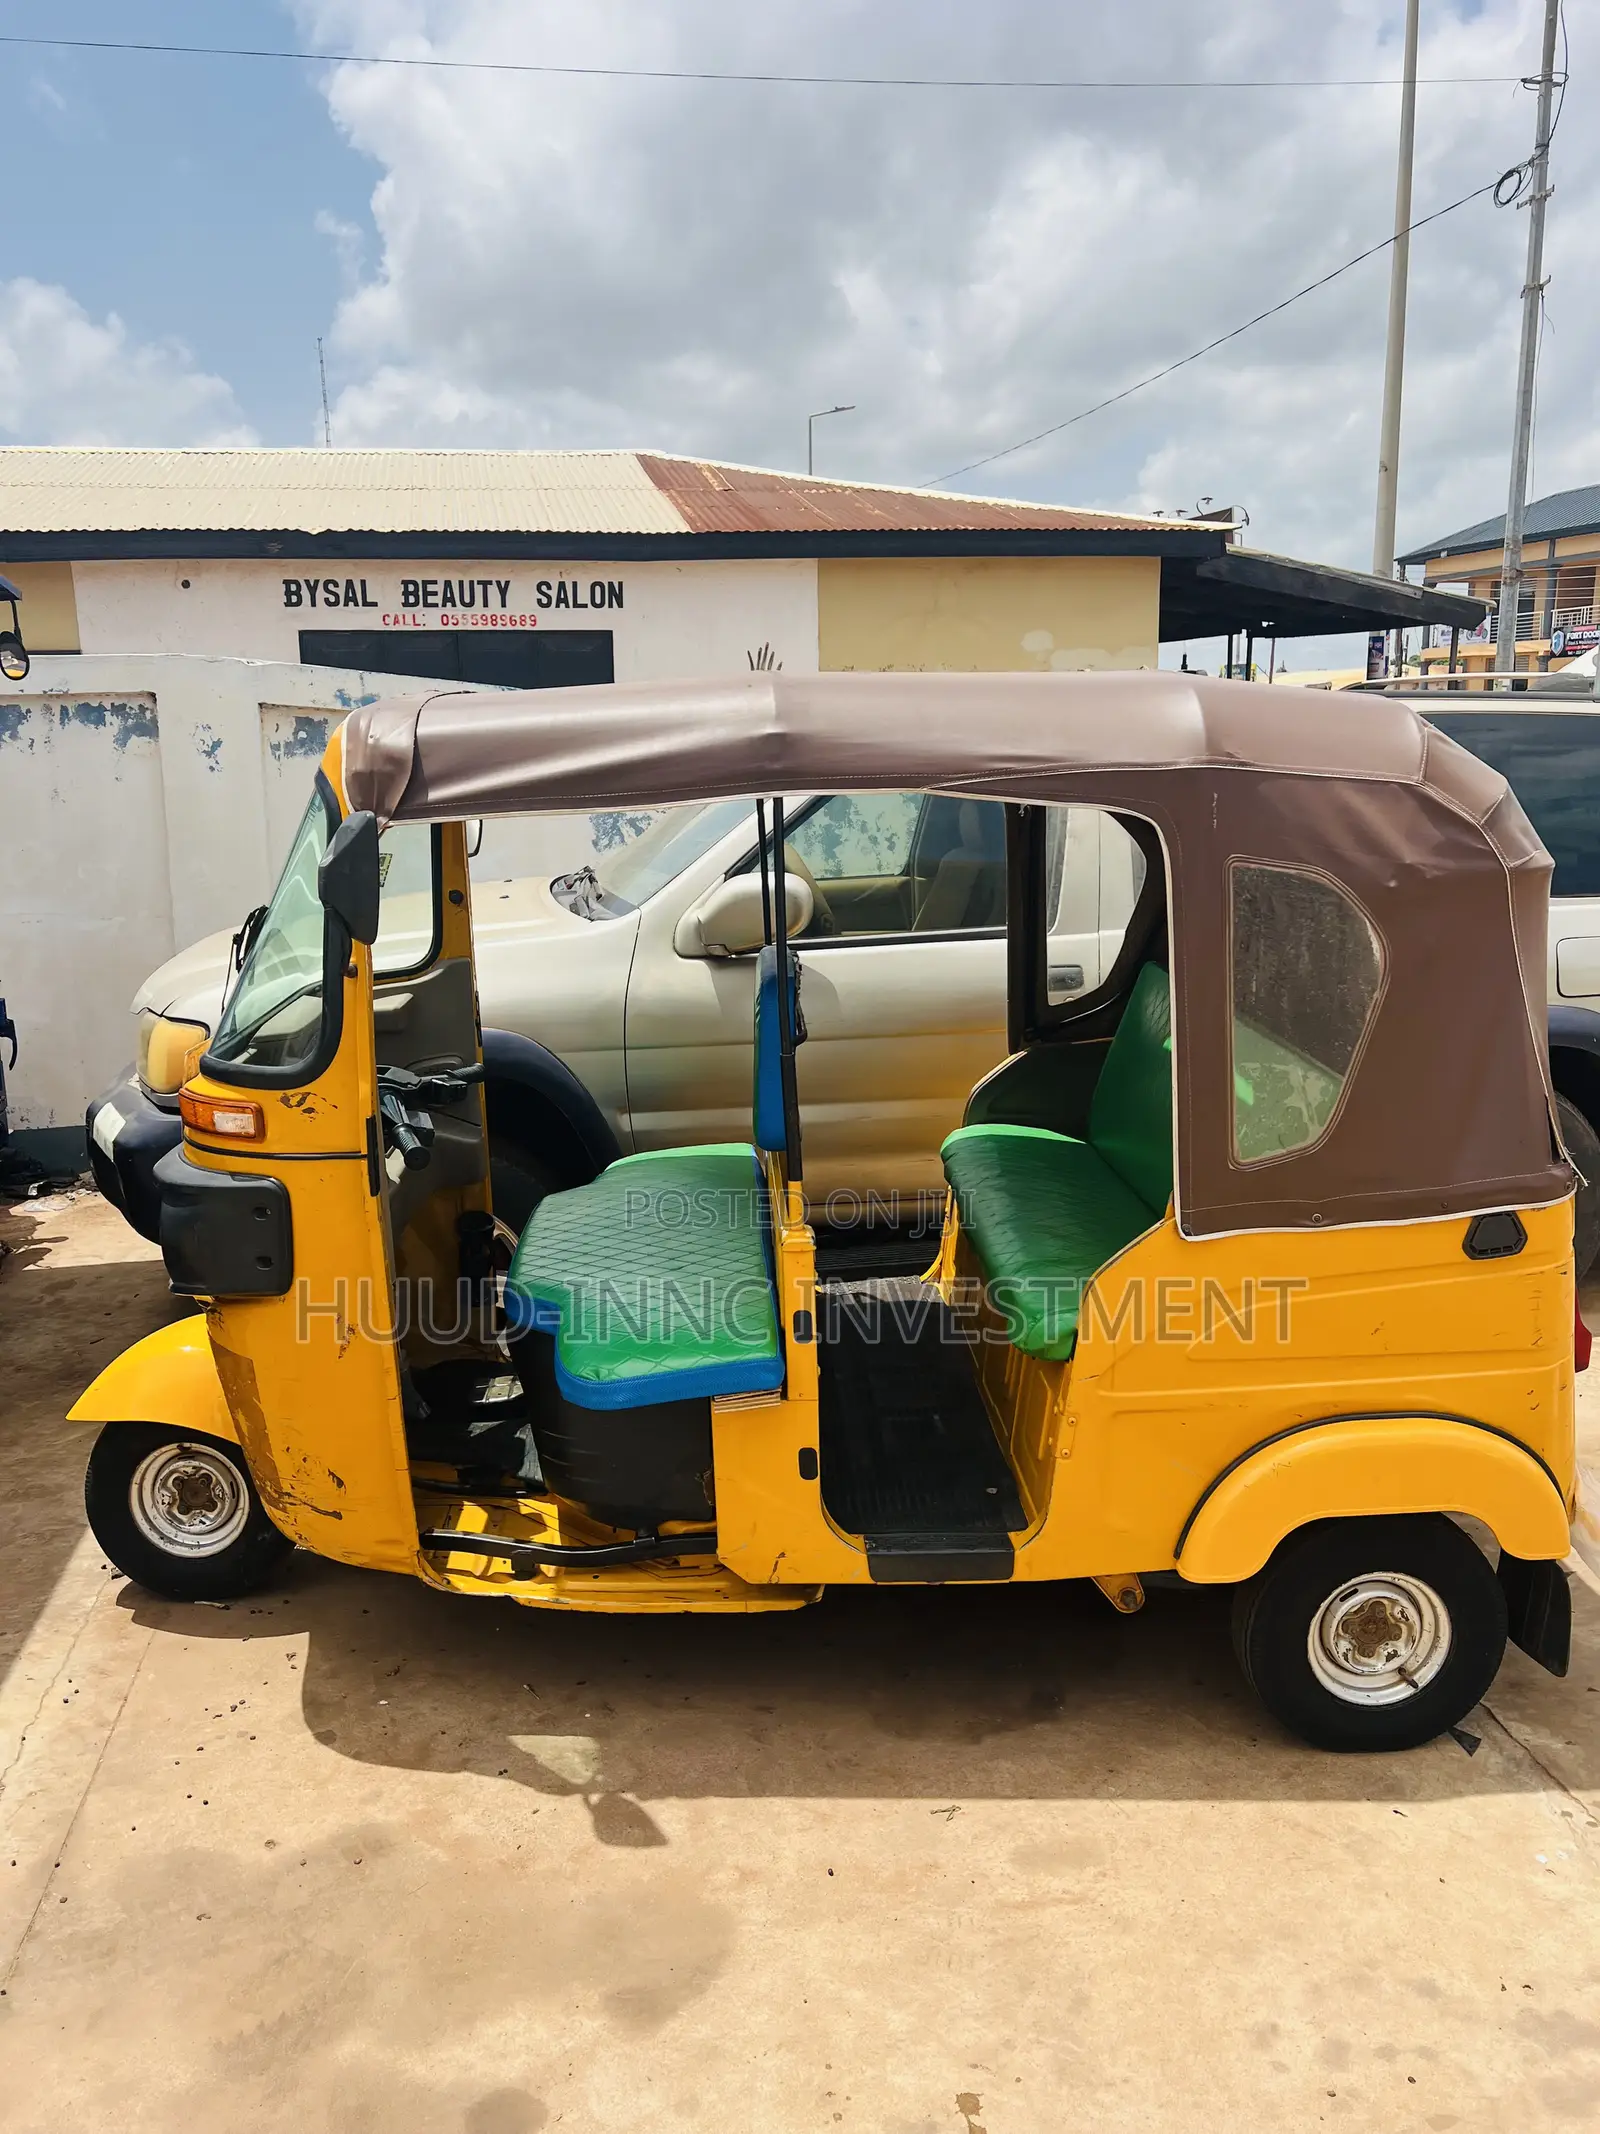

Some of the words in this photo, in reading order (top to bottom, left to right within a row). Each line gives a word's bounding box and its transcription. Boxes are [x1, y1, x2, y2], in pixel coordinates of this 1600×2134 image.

[282, 579, 378, 608] BYSAL
[401, 579, 510, 608] BEAUTY
[536, 580, 624, 609] SALON
[382, 613, 427, 627] CALL:
[440, 613, 537, 627] 0555989689
